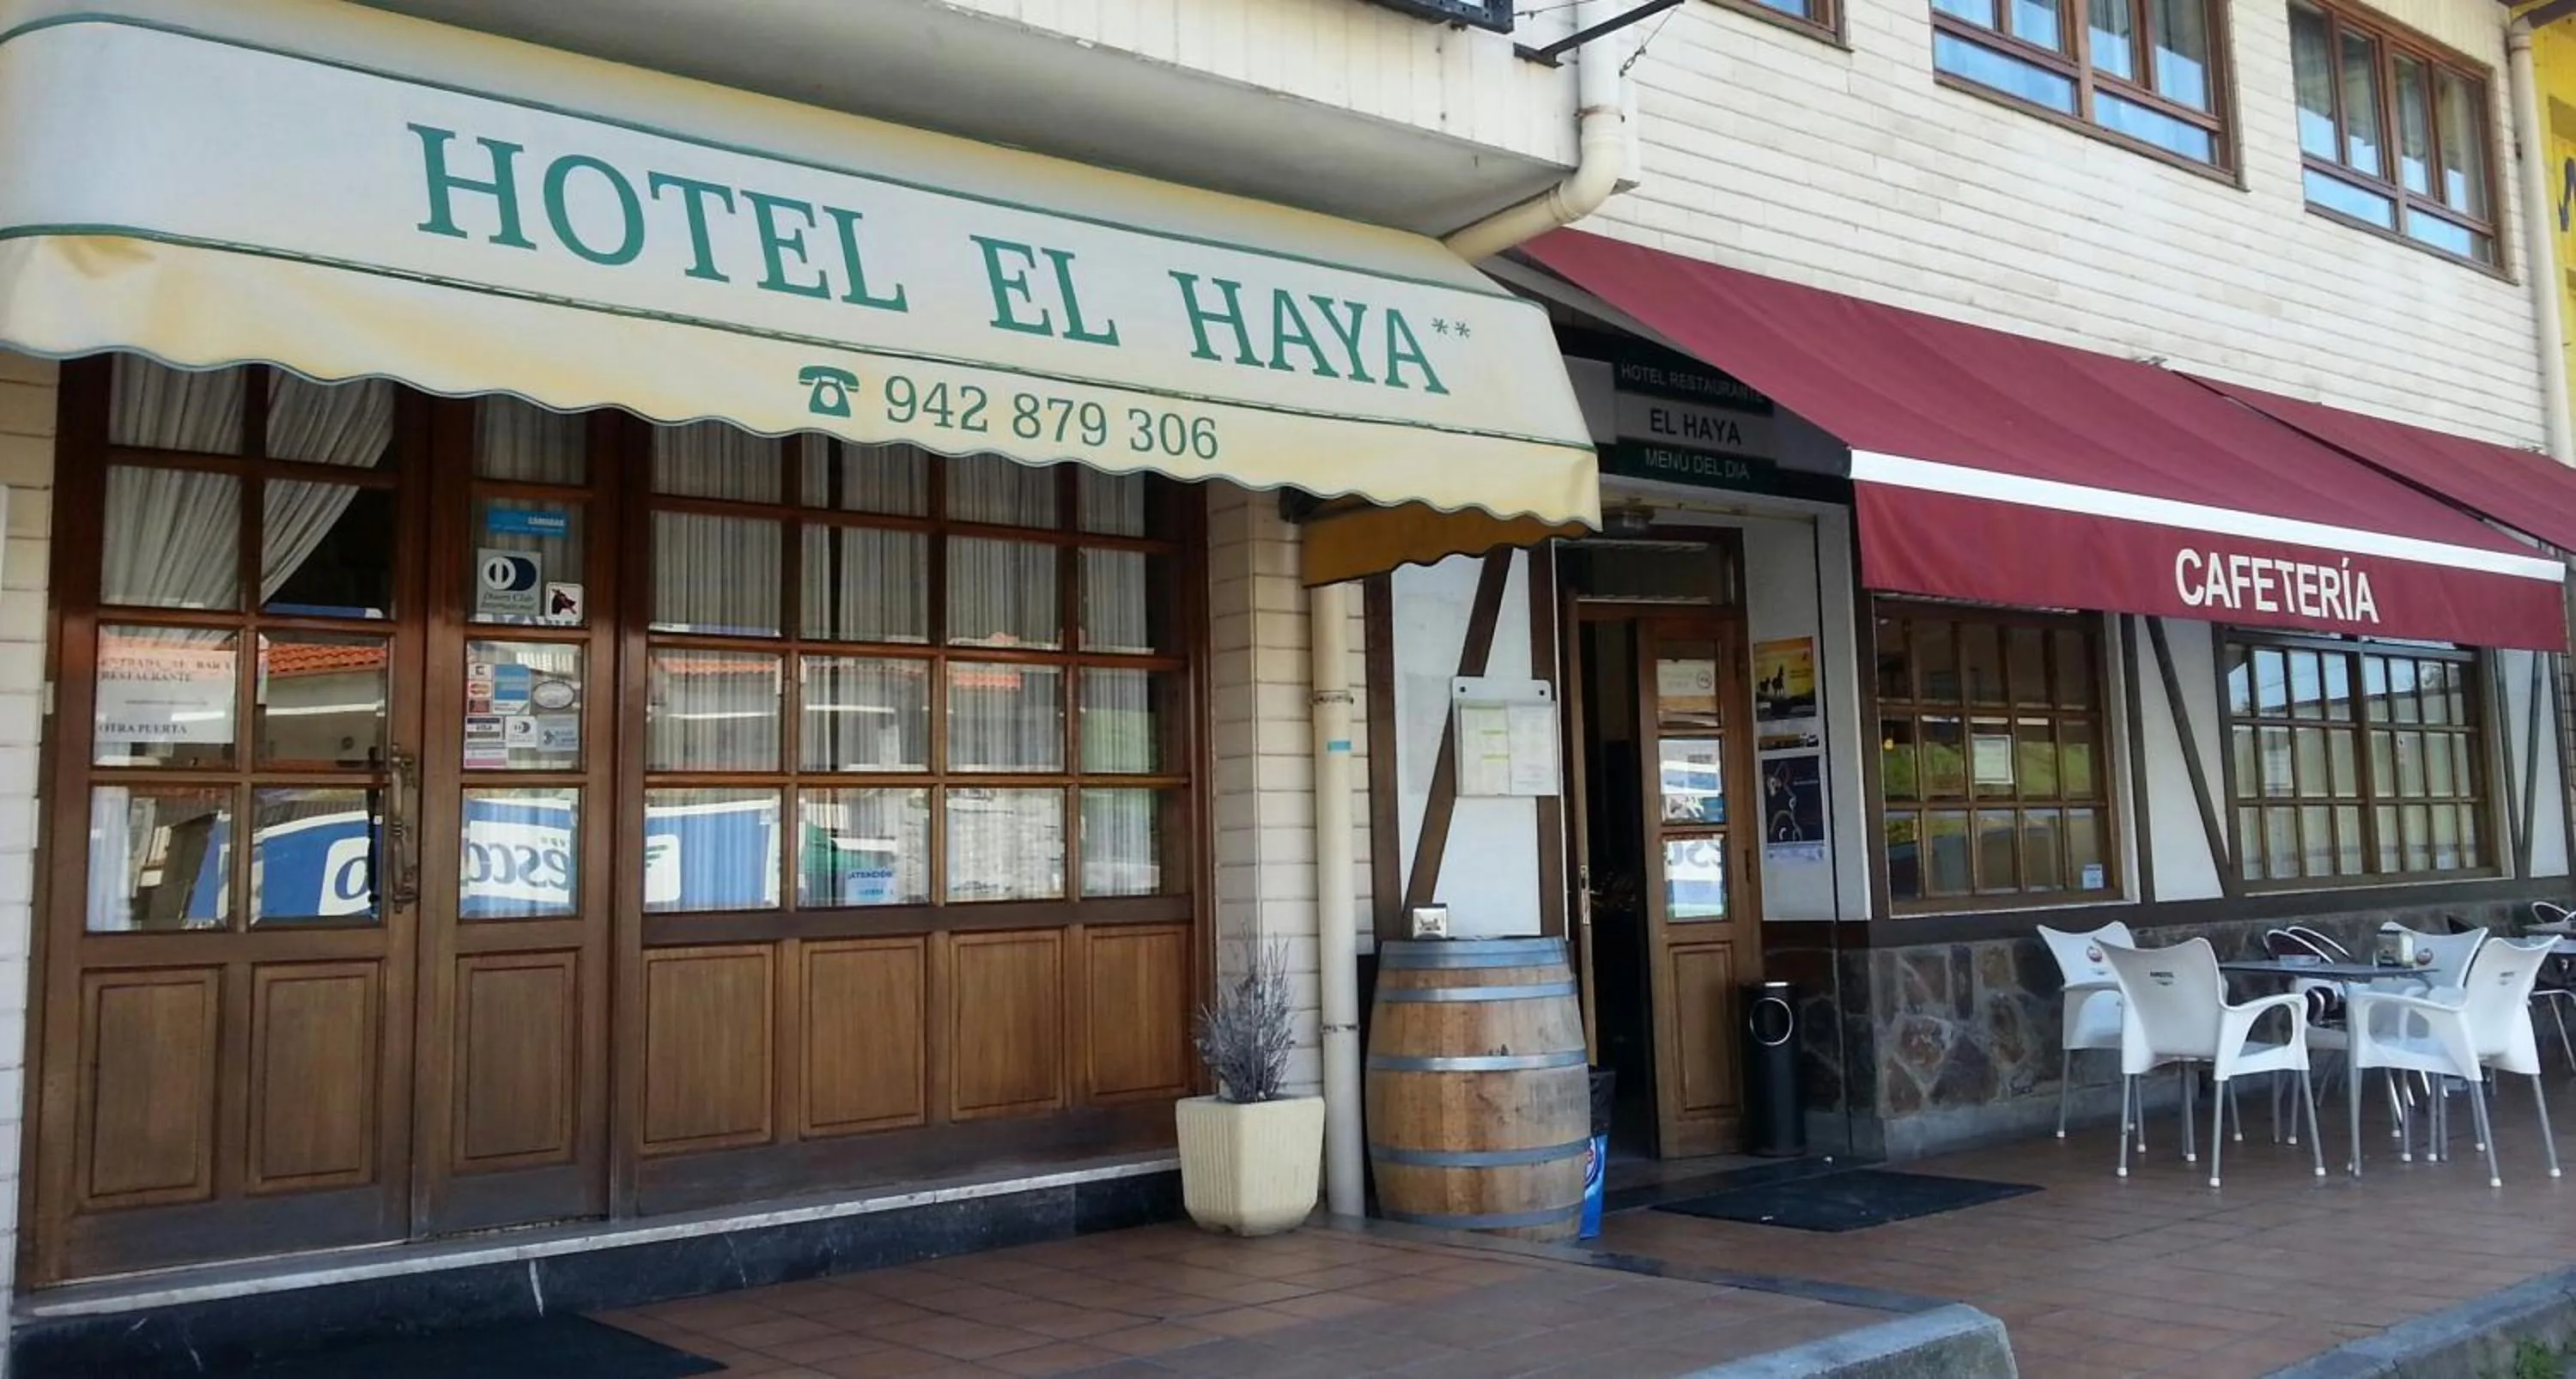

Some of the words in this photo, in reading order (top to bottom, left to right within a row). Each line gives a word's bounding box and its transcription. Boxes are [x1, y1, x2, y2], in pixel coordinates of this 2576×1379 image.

[407, 122, 908, 313] HOTEL
[969, 234, 1120, 347] EL
[1621, 363, 1666, 386] HOTEL
[1669, 371, 1765, 404] RESTAURANTE
[884, 374, 988, 433] 942
[1012, 392, 1109, 448] 879
[1127, 408, 1219, 460] 306
[1650, 408, 1676, 434] EL
[1684, 414, 1741, 447] HAYA
[1692, 455, 1722, 476] DEL
[2175, 548, 2380, 624] CAFETERÍA
[137, 724, 188, 735] PUERTA
